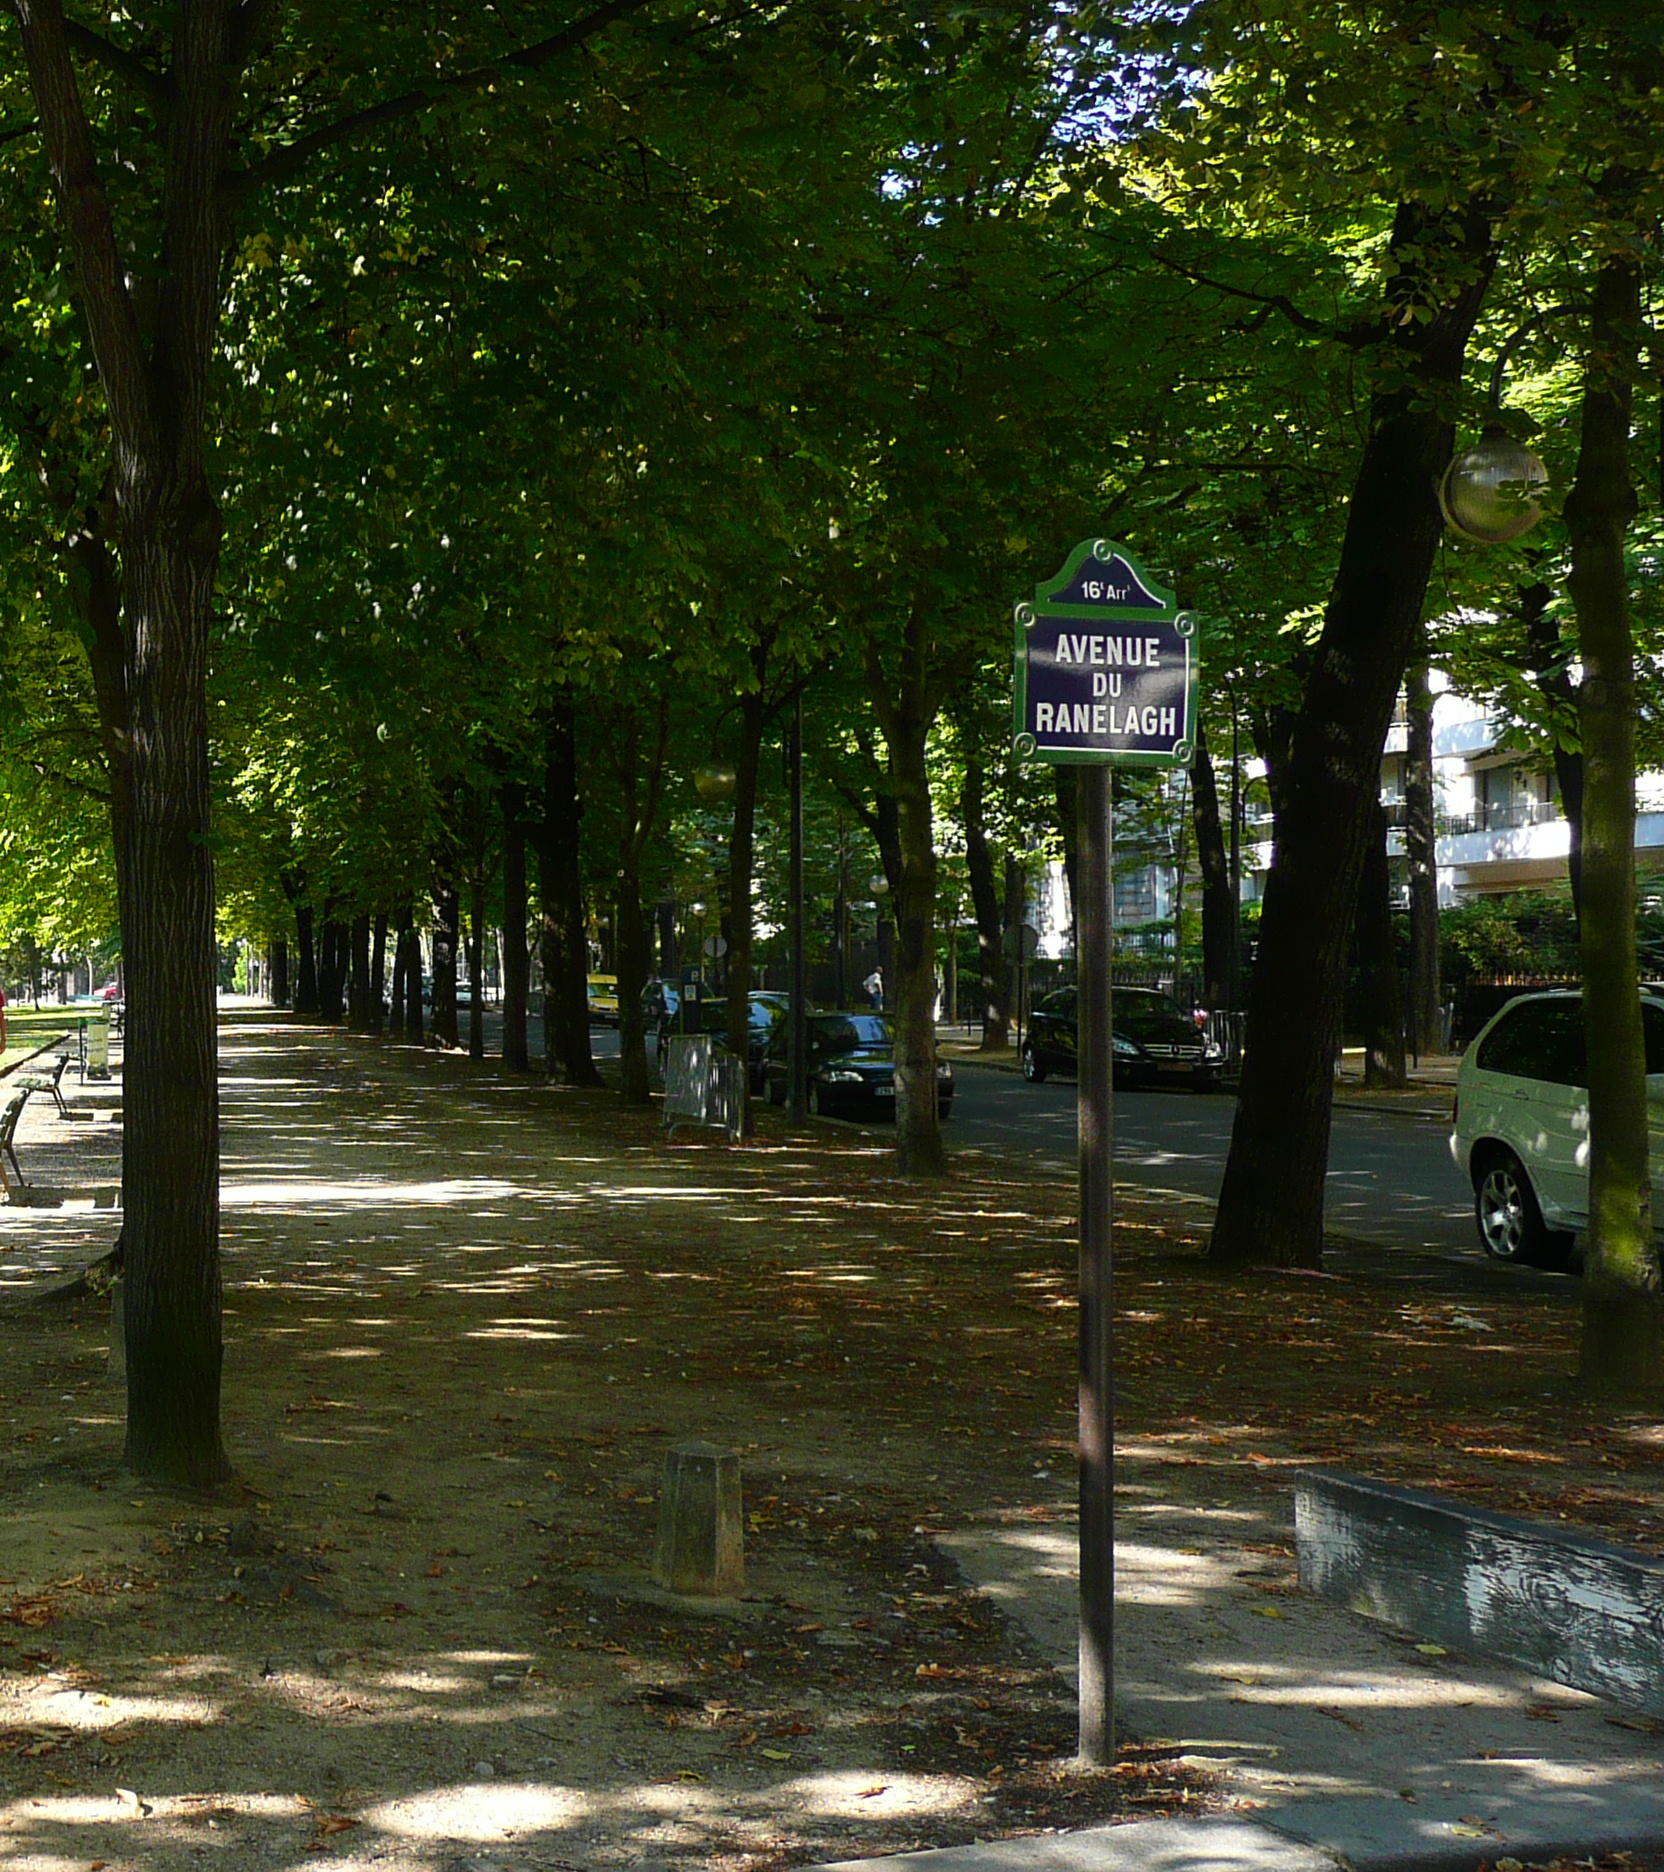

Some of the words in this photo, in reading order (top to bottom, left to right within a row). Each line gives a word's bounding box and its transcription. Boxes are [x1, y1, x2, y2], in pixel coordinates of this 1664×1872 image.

[1055, 633, 1161, 667] AVENUE
[1092, 672, 1122, 698] DU
[1036, 702, 1176, 736] RANELAGH
